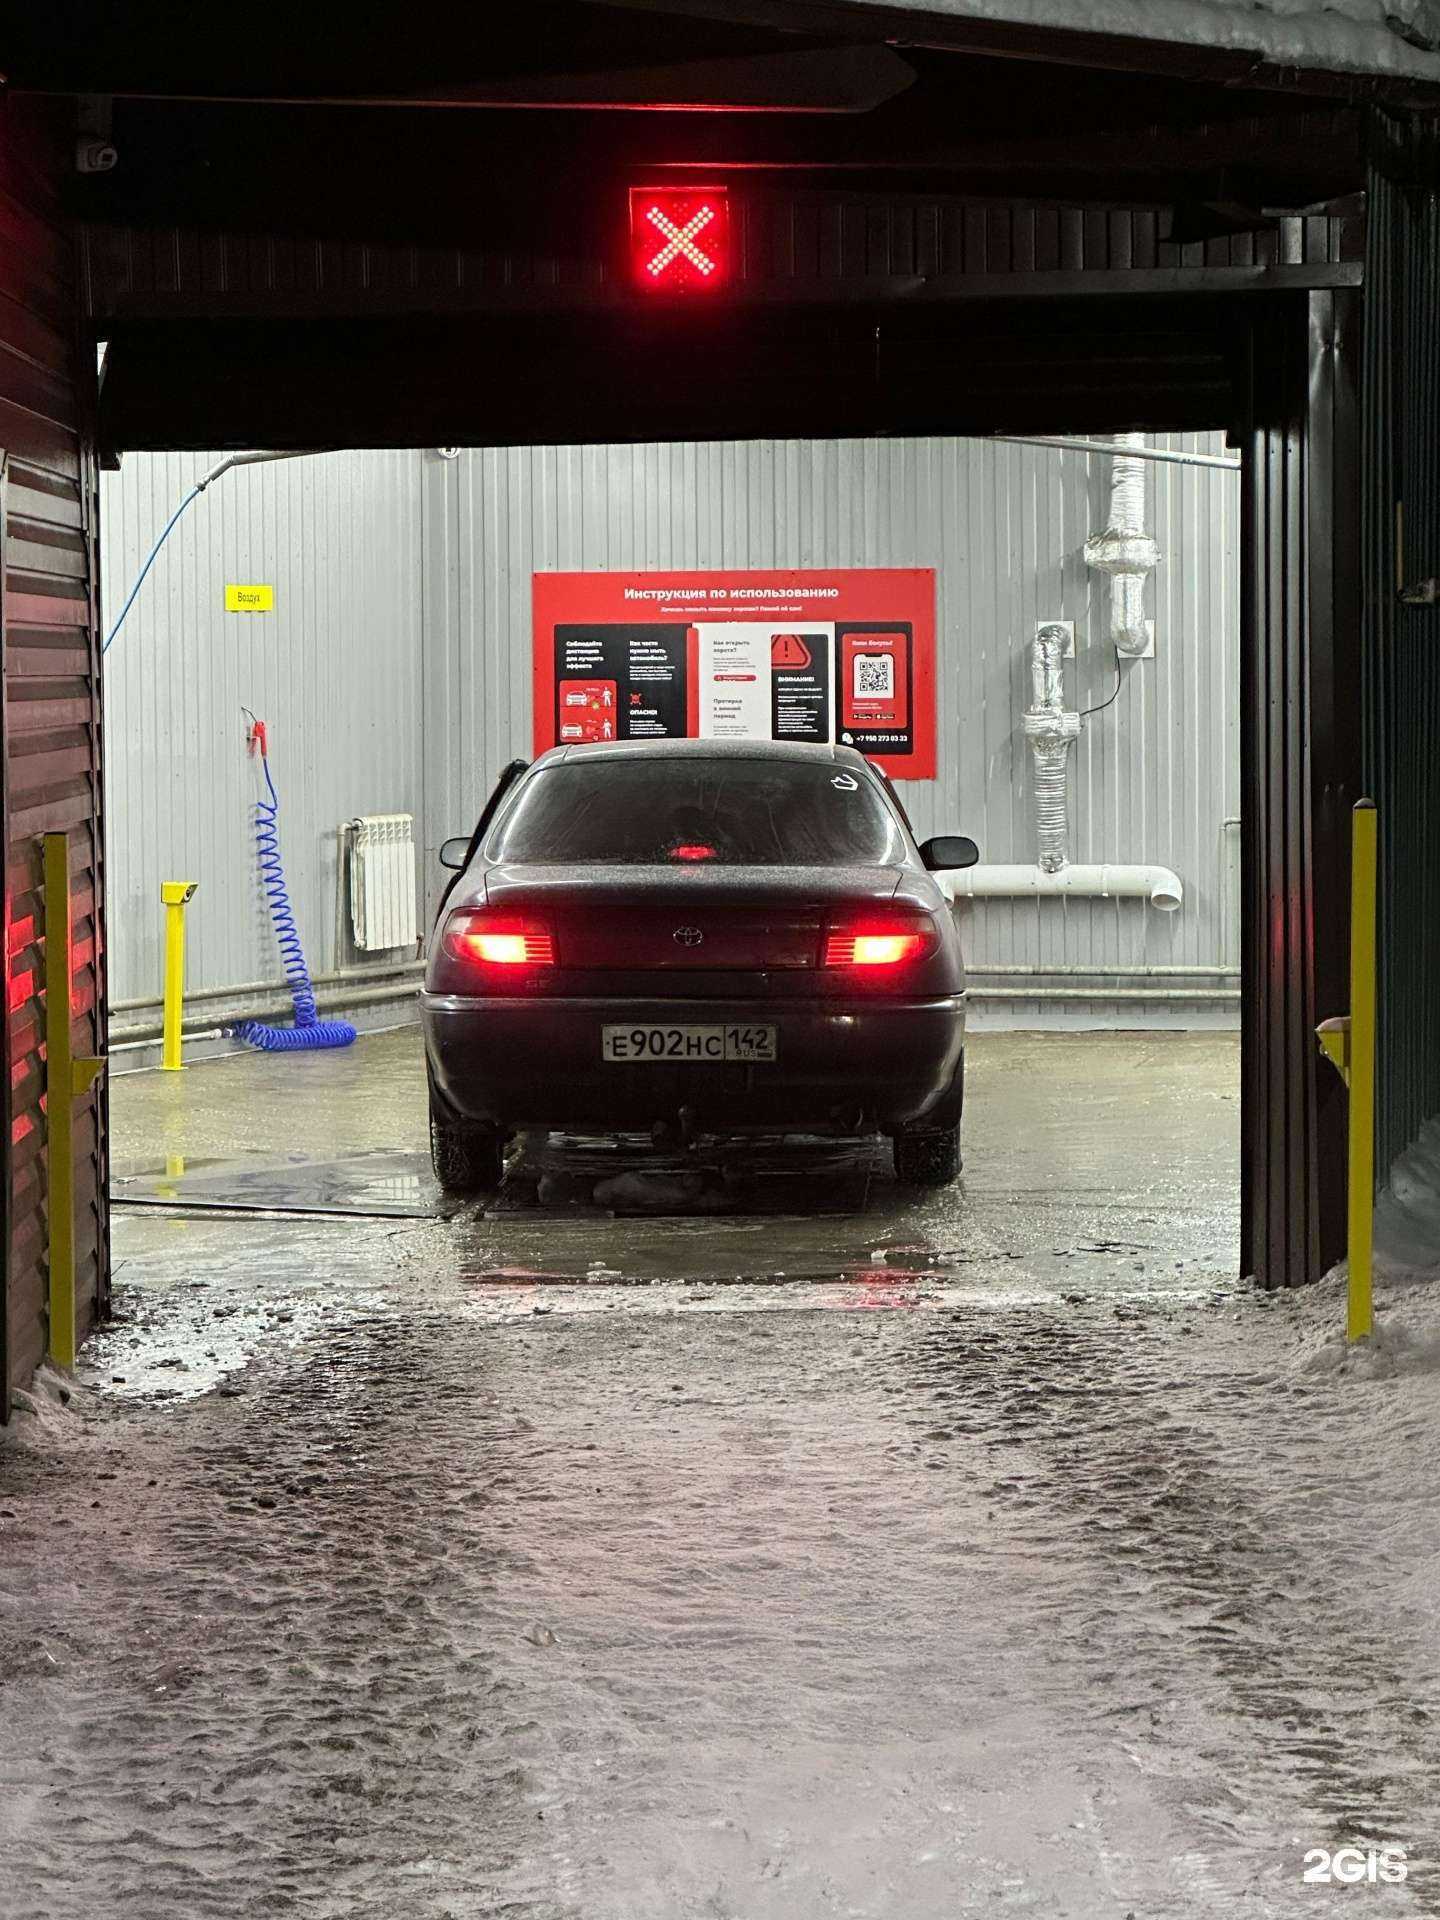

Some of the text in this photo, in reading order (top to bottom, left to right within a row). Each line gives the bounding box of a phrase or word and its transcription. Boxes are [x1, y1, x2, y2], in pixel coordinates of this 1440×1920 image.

[237, 591, 261, 605] Воздух
[624, 588, 839, 601] Инструкция по использованию
[728, 1029, 768, 1050] 142
